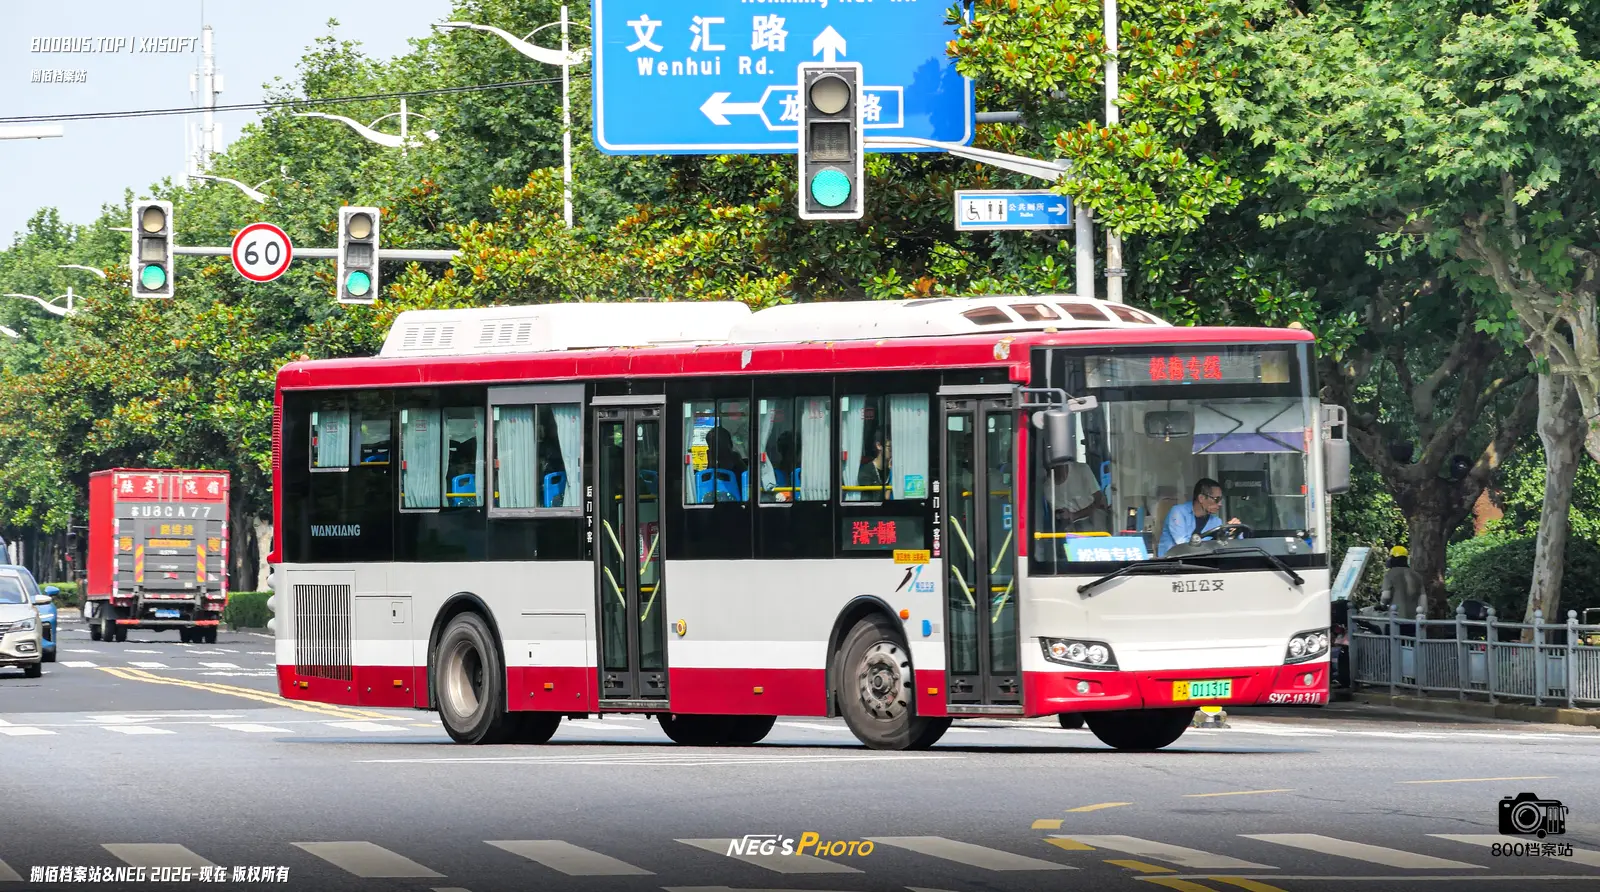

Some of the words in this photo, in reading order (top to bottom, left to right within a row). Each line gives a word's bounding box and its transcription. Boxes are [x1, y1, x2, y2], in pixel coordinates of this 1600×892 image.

[625, 14, 788, 52] 文汇路
[637, 57, 721, 76] Wenhui
[738, 56, 775, 75] Rd.
[244, 241, 280, 266] 60
[1149, 355, 1223, 381] 松梅专线
[310, 524, 361, 537] WANXIANG
[1171, 579, 1225, 594] 松江公交
